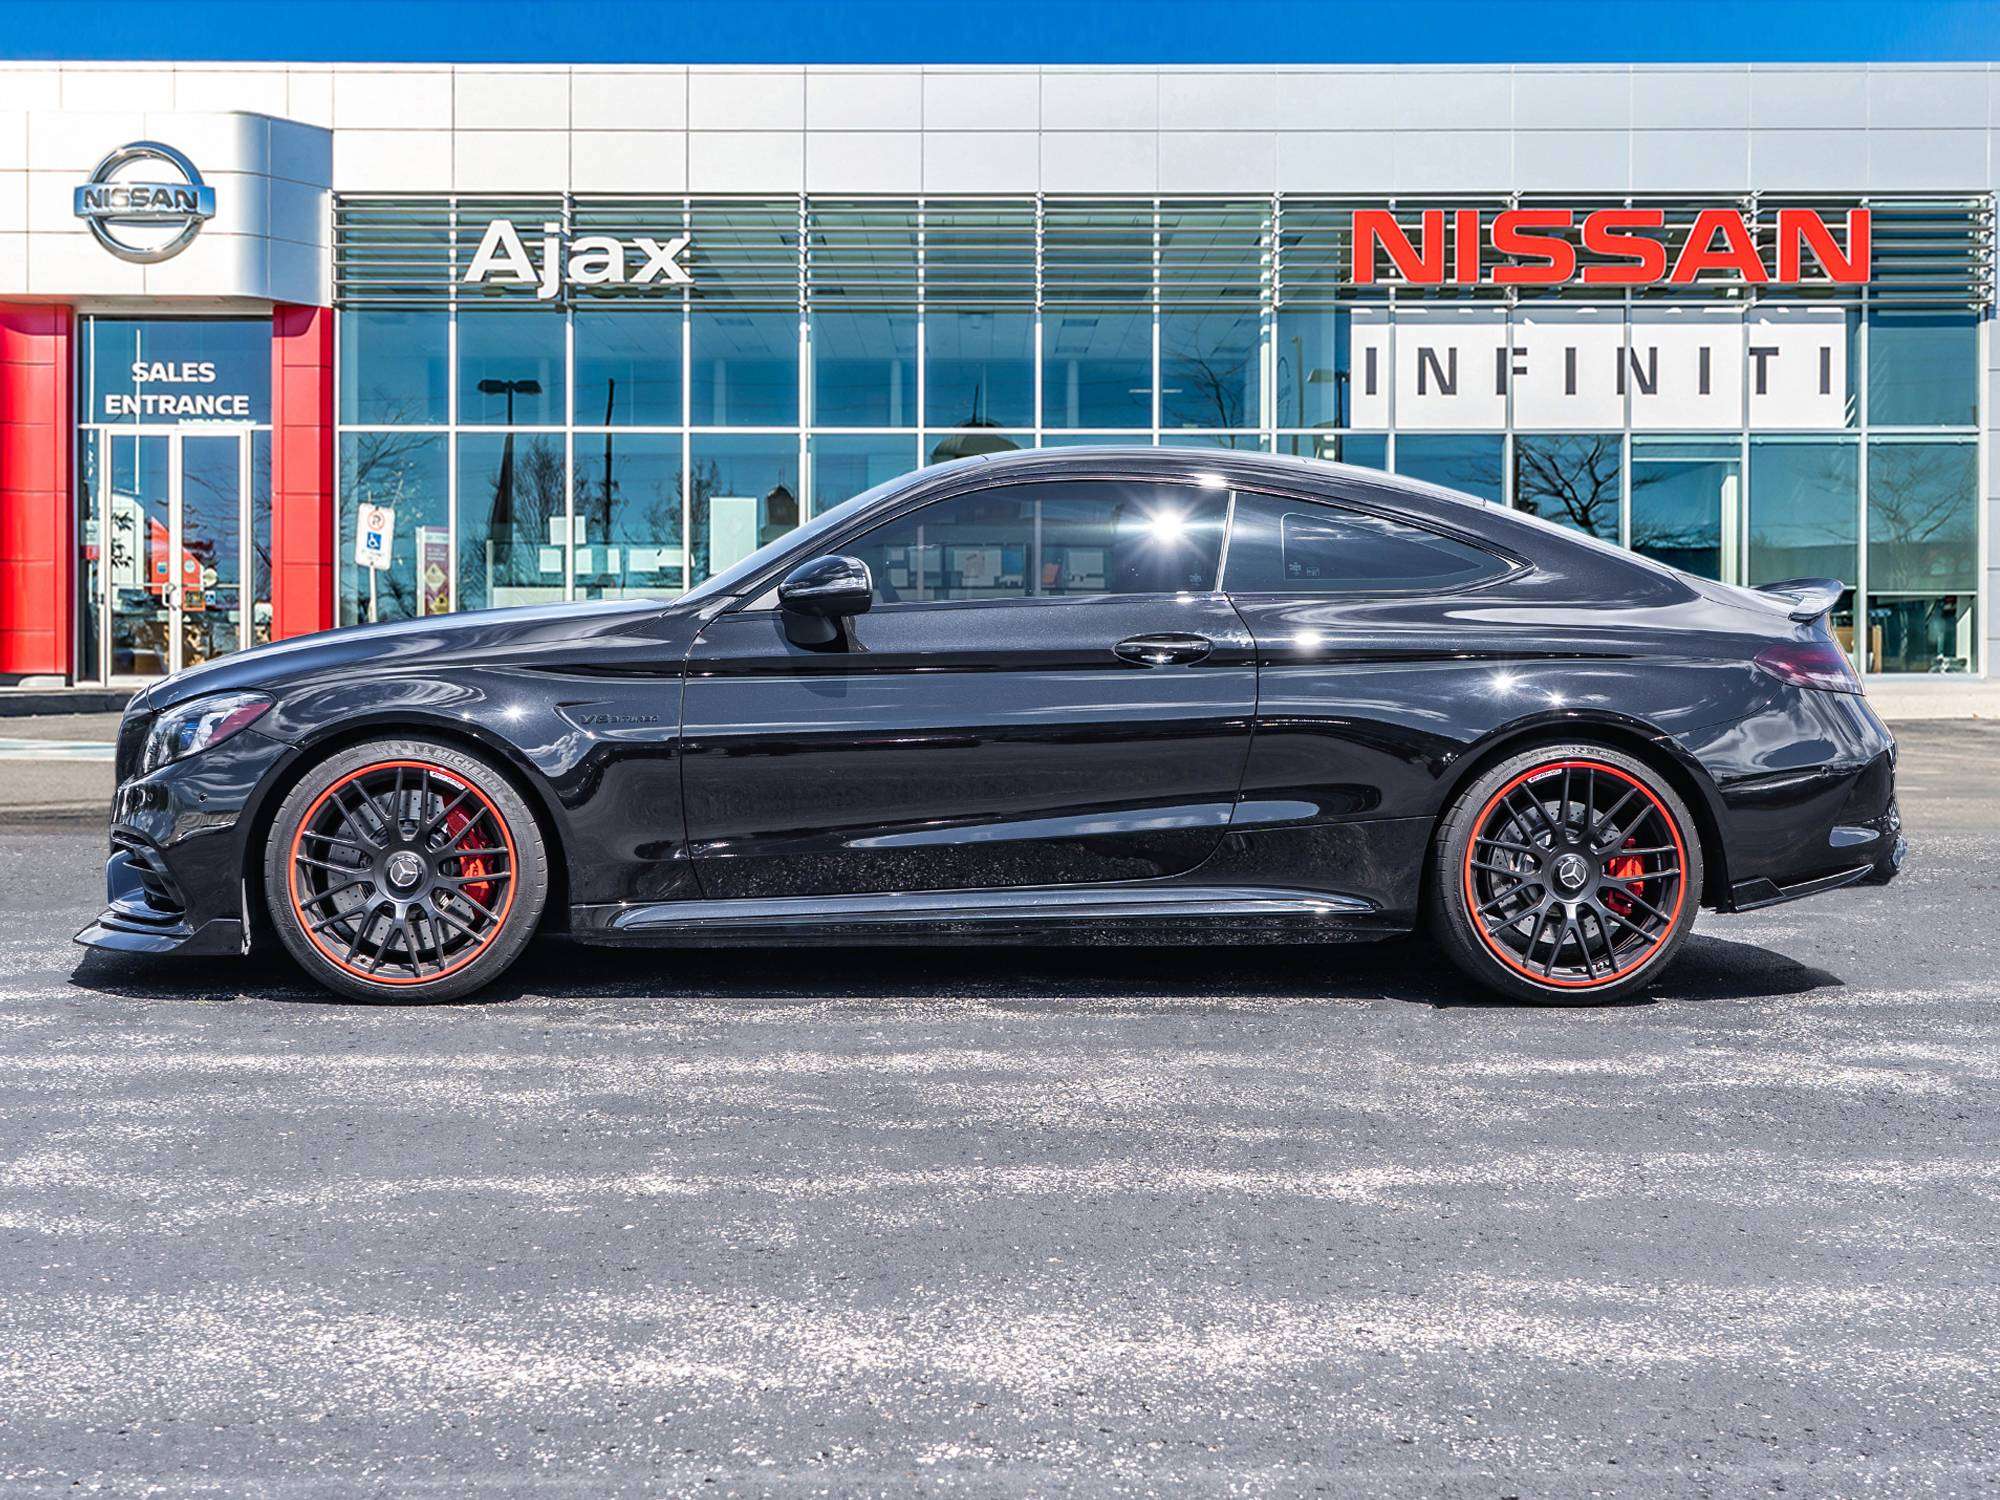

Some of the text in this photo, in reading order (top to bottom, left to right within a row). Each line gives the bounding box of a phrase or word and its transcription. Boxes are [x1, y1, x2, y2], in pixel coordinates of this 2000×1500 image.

[84, 187, 199, 209] NISSAN
[463, 219, 695, 300] Ajax
[1351, 208, 1872, 284] NISSAN
[132, 362, 216, 382] SALES
[1366, 346, 1831, 395] INFINITI
[105, 394, 249, 415] ENTRANCE
